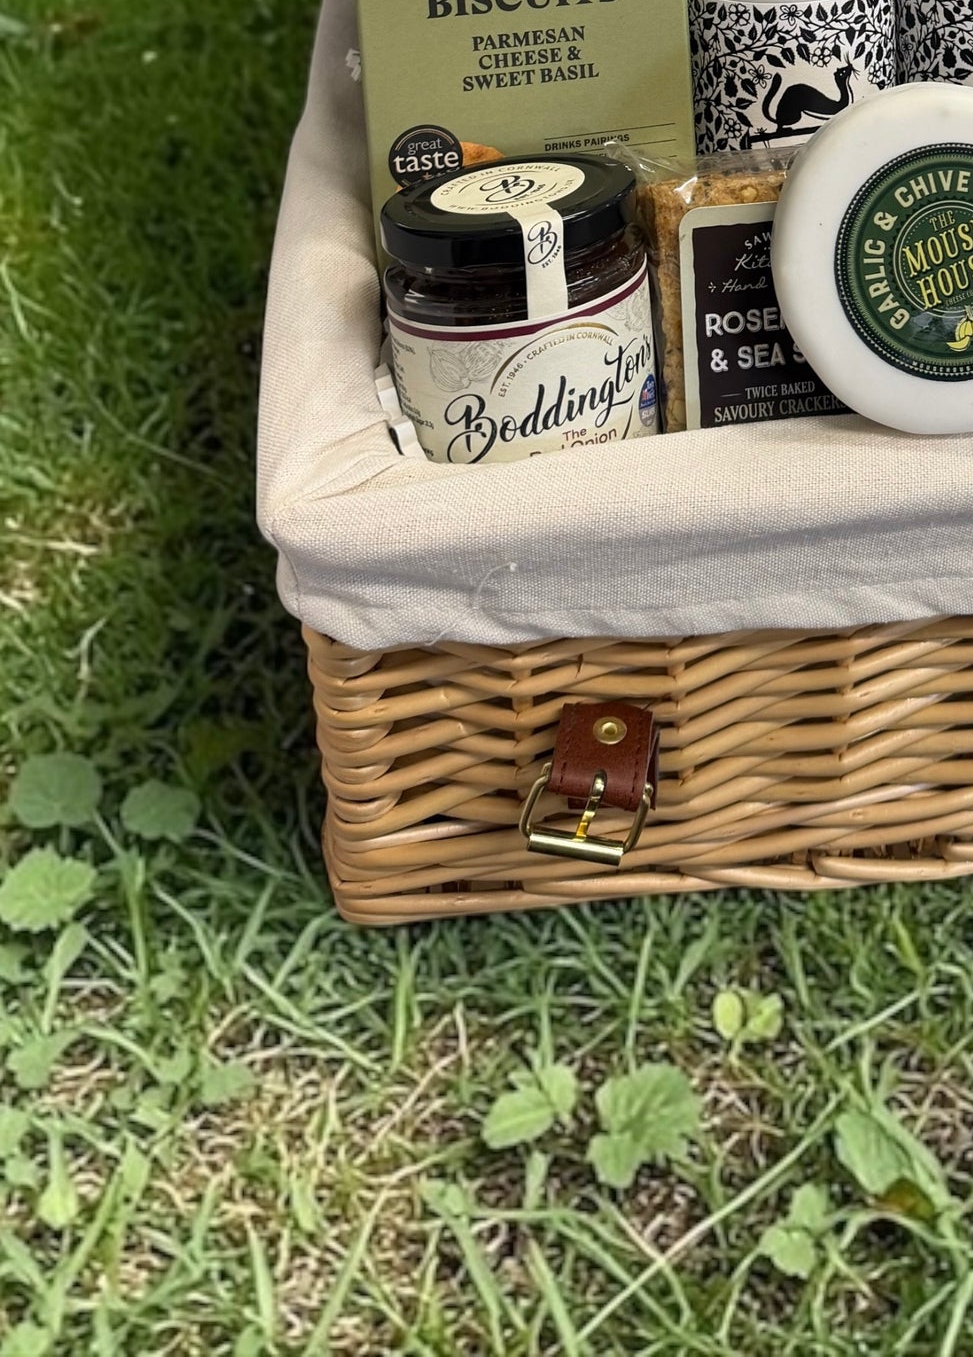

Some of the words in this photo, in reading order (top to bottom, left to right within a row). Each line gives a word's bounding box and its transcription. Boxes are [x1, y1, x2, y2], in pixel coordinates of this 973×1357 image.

[472, 26, 585, 52] PARMESAN
[478, 48, 564, 70] CHEESE
[567, 45, 582, 61] &
[462, 69, 535, 92] SWEET
[540, 63, 600, 84] BASIL
[407, 137, 442, 156] great
[544, 140, 582, 152] DRINKS
[393, 148, 460, 175] taste
[893, 170, 971, 208] CHIVE
[873, 210, 898, 231] &
[929, 210, 955, 231] THE
[722, 275, 769, 293] Hand
[863, 239, 911, 330] GARLIC
[945, 292, 965, 307] CHEESE
[705, 306, 786, 337] ROSE
[497, 381, 512, 398] EST.
[507, 362, 524, 381] 1946
[526, 337, 566, 361] CRAFTED
[566, 332, 575, 341] IN
[576, 331, 613, 347] CORNWALL
[710, 348, 729, 373] &
[737, 342, 786, 370] SEA
[444, 334, 652, 464] Boddington's
[745, 385, 778, 399] TWICE
[780, 381, 816, 394] BAKED
[714, 399, 775, 423] SAVOURY
[562, 427, 587, 442] The
